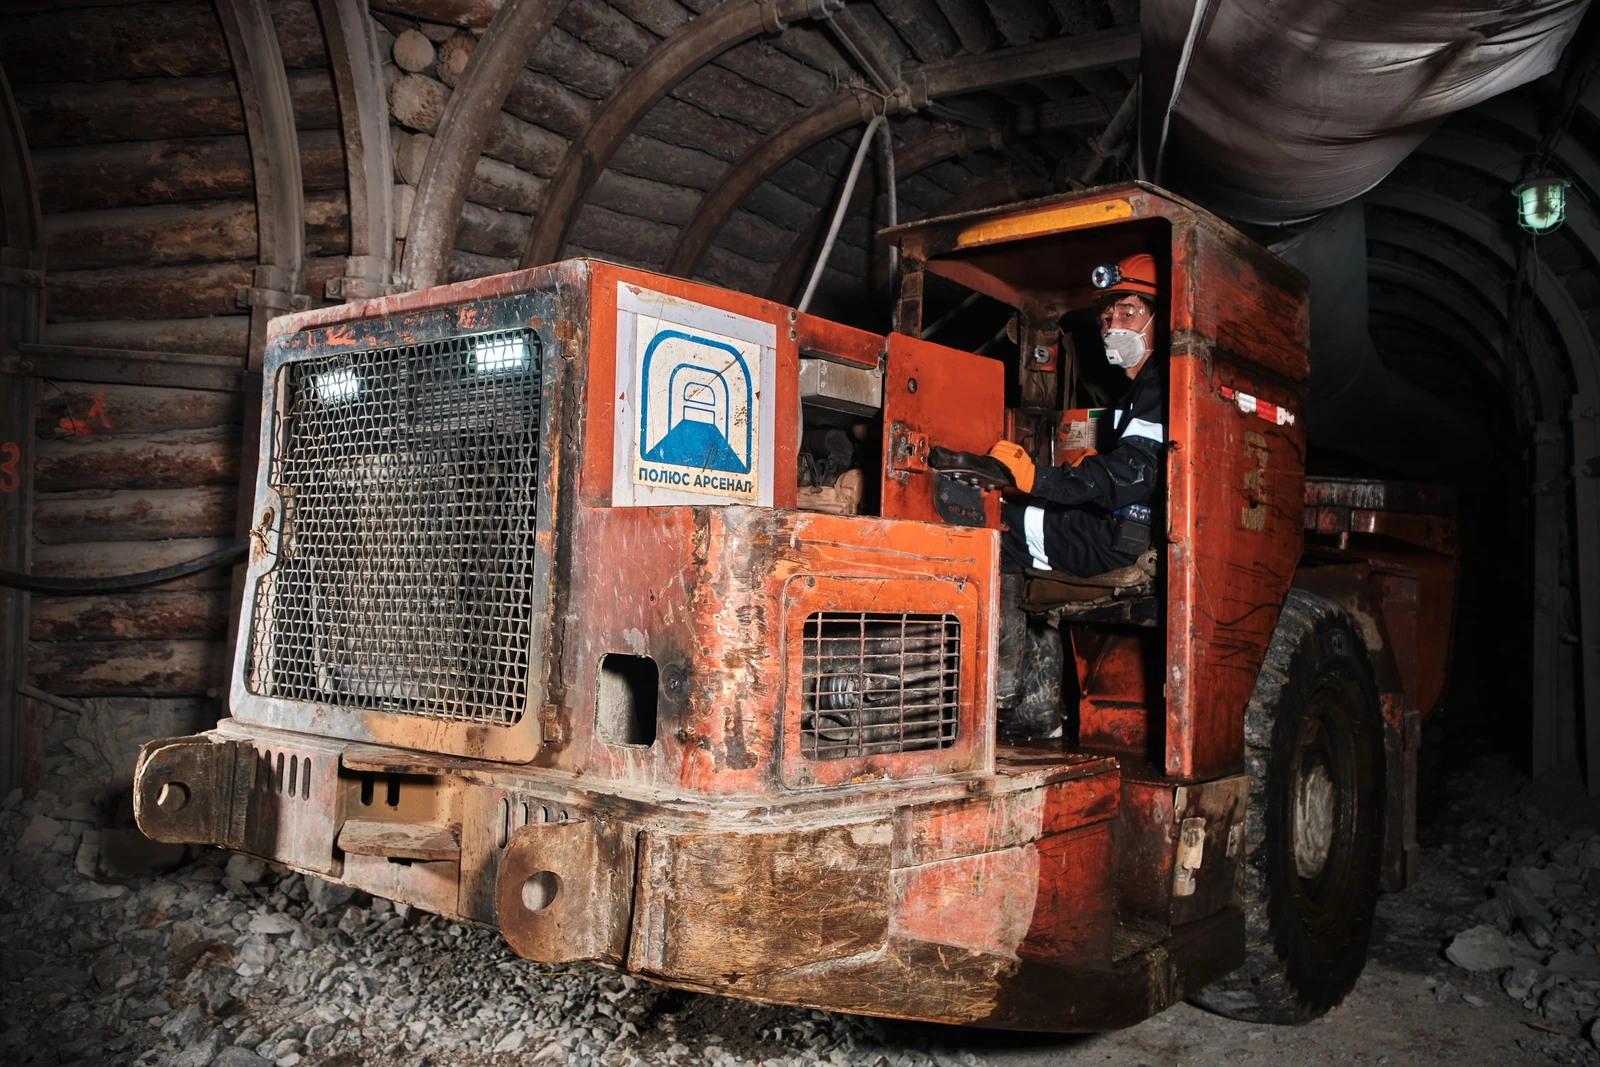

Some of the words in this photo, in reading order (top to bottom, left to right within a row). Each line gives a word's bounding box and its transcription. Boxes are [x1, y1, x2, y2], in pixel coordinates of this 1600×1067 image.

[0, 442, 20, 492] 3
[638, 467, 691, 486] ПОЛЮС
[693, 475, 752, 493] АРСЕНАЛ
